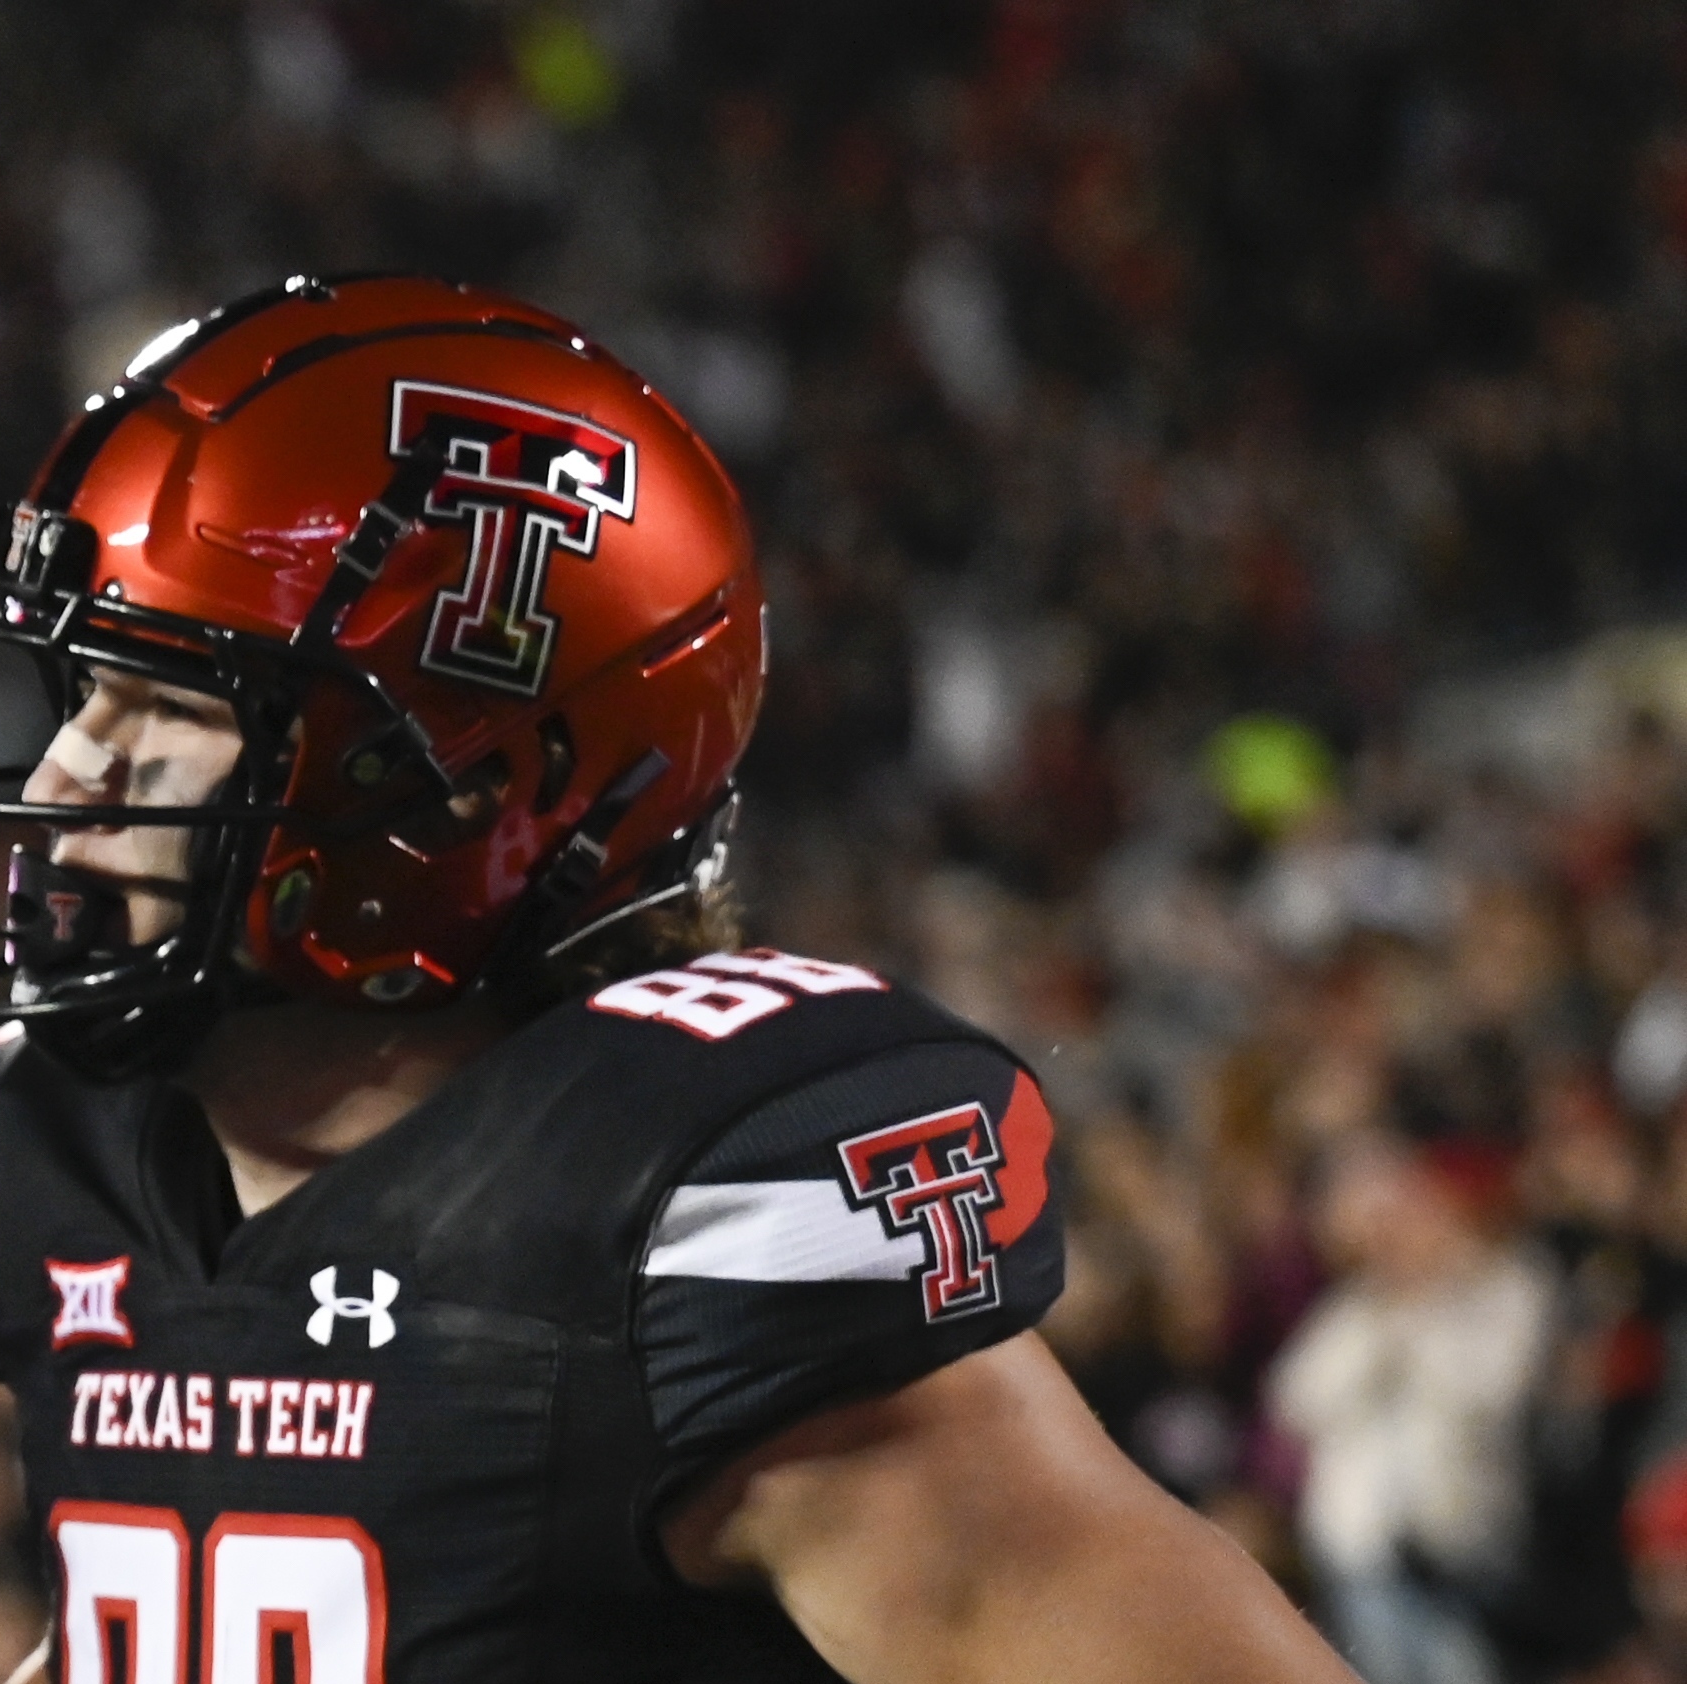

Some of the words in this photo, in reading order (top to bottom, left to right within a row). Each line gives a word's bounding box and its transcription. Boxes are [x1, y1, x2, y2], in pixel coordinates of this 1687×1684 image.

[586, 946, 892, 1043] 88
[46, 1258, 133, 1347] XII
[70, 1370, 214, 1454] TEXAS
[227, 1376, 375, 1461] TECH
